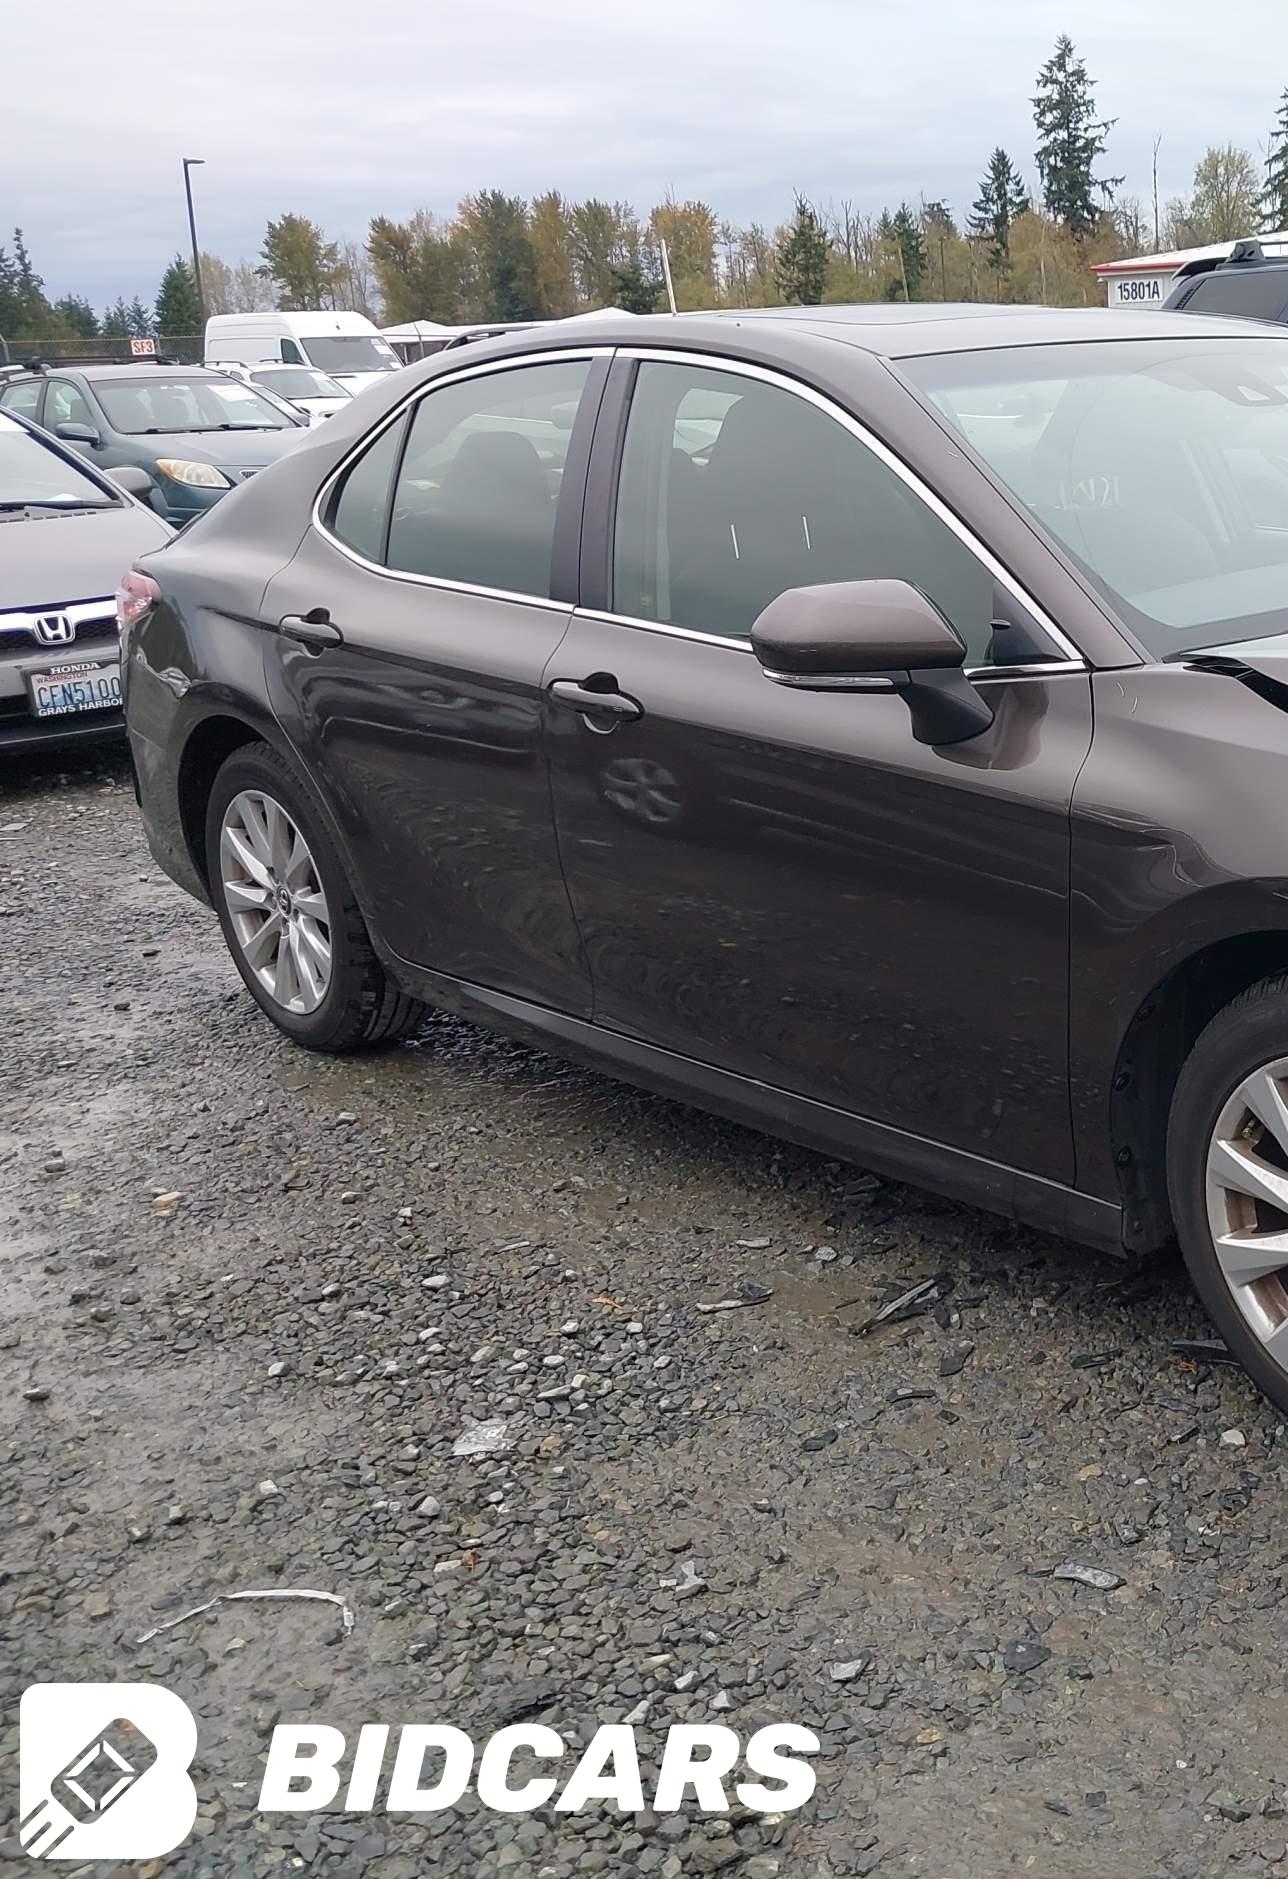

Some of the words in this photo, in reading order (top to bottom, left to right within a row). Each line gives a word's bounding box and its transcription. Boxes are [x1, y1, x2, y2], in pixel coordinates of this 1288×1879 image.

[1117, 281, 1160, 301] 15801A
[133, 341, 153, 353] SF3
[50, 662, 101, 674] HONDA
[36, 671, 88, 684] WASHINGTON
[38, 704, 76, 717] GRAYS
